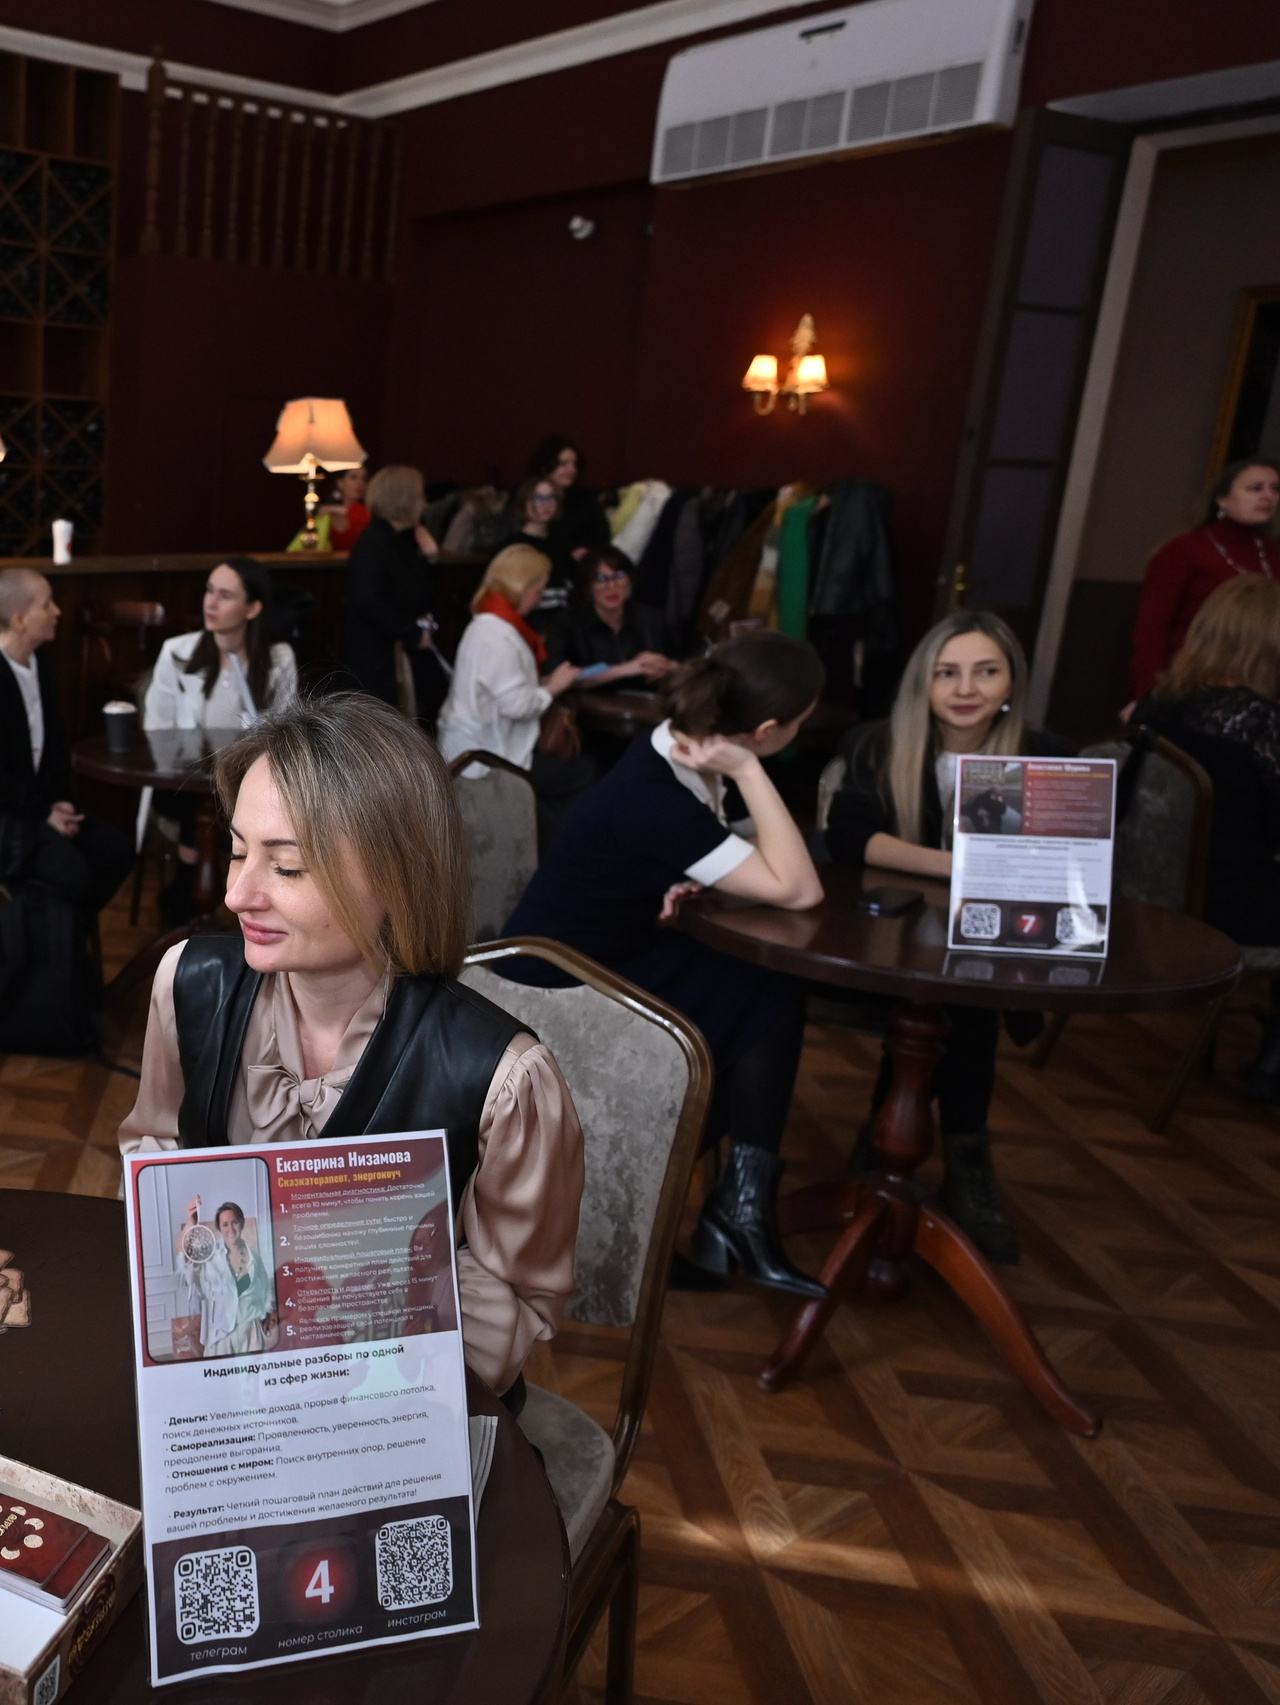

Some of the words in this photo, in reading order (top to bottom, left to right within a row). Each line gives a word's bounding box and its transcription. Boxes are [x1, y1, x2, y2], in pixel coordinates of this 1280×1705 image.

[1021, 915, 1036, 934] 7
[275, 1156, 344, 1173] Екатерина
[348, 1151, 411, 1167] Низамова
[277, 1174, 350, 1188] Сказкатерапевт,
[352, 1168, 401, 1182] энергокоуч
[387, 1183, 424, 1192] Достаточно
[280, 1202, 289, 1214] 1.
[291, 1202, 311, 1210] всего
[344, 1196, 364, 1204] чтобы
[366, 1194, 388, 1203] понять
[414, 1189, 435, 1199] вашей
[320, 1218, 368, 1229] определение
[383, 1215, 407, 1223] быстро
[279, 1235, 290, 1246] 2.
[293, 1232, 341, 1242] безошибочно
[368, 1226, 404, 1235] глубинные
[282, 1265, 293, 1276] 3.
[328, 1259, 369, 1270] конкретный
[420, 1253, 431, 1261] для
[284, 1297, 296, 1308] 4.
[286, 1325, 296, 1336] 5.
[203, 1359, 301, 1378] Индивидуальные
[305, 1352, 353, 1367] разборы
[355, 1349, 369, 1359] по
[371, 1343, 404, 1357] одной
[264, 1377, 277, 1386] из
[279, 1373, 308, 1385] сфер
[310, 1367, 350, 1380] жизни:
[168, 1412, 208, 1427] Деньги:
[209, 1407, 266, 1421] Увеличение
[268, 1401, 302, 1414] дохода,
[304, 1396, 338, 1409] прорыв
[340, 1389, 398, 1405] финансового
[400, 1384, 436, 1394] потолка,
[162, 1429, 191, 1440] поиск
[192, 1422, 241, 1438] денежных
[242, 1415, 299, 1430] источников.
[170, 1432, 256, 1453] Самореализация:
[257, 1425, 330, 1441] Проявленность,
[331, 1416, 390, 1433] уверенность,
[391, 1410, 429, 1423] энергия,
[163, 1450, 227, 1467] преодоление
[229, 1443, 282, 1457] выгорания.
[171, 1465, 228, 1479] Отношения
[238, 1457, 273, 1470] миром:
[276, 1455, 304, 1465] Поиск
[306, 1445, 359, 1461] внутренних
[360, 1442, 385, 1453] опор,
[386, 1436, 426, 1451] решение
[165, 1481, 207, 1494] проблем
[216, 1470, 278, 1486] окружением.
[173, 1503, 225, 1518] Результат:
[226, 1498, 260, 1511] Четкий
[262, 1490, 316, 1507] пошаговый
[318, 1488, 339, 1499] план
[341, 1481, 383, 1496] действий
[384, 1479, 401, 1489] для
[402, 1472, 442, 1486] решения
[166, 1520, 197, 1534] вашей
[199, 1514, 248, 1528] проблемы
[257, 1503, 316, 1521] достижения
[317, 1497, 366, 1512] желаемого
[368, 1488, 417, 1505] результата!
[303, 1558, 335, 1607] 4
[386, 1606, 446, 1627] инстаграм
[277, 1632, 315, 1648] номер
[316, 1621, 363, 1642] столика
[190, 1641, 247, 1662] телеграм
